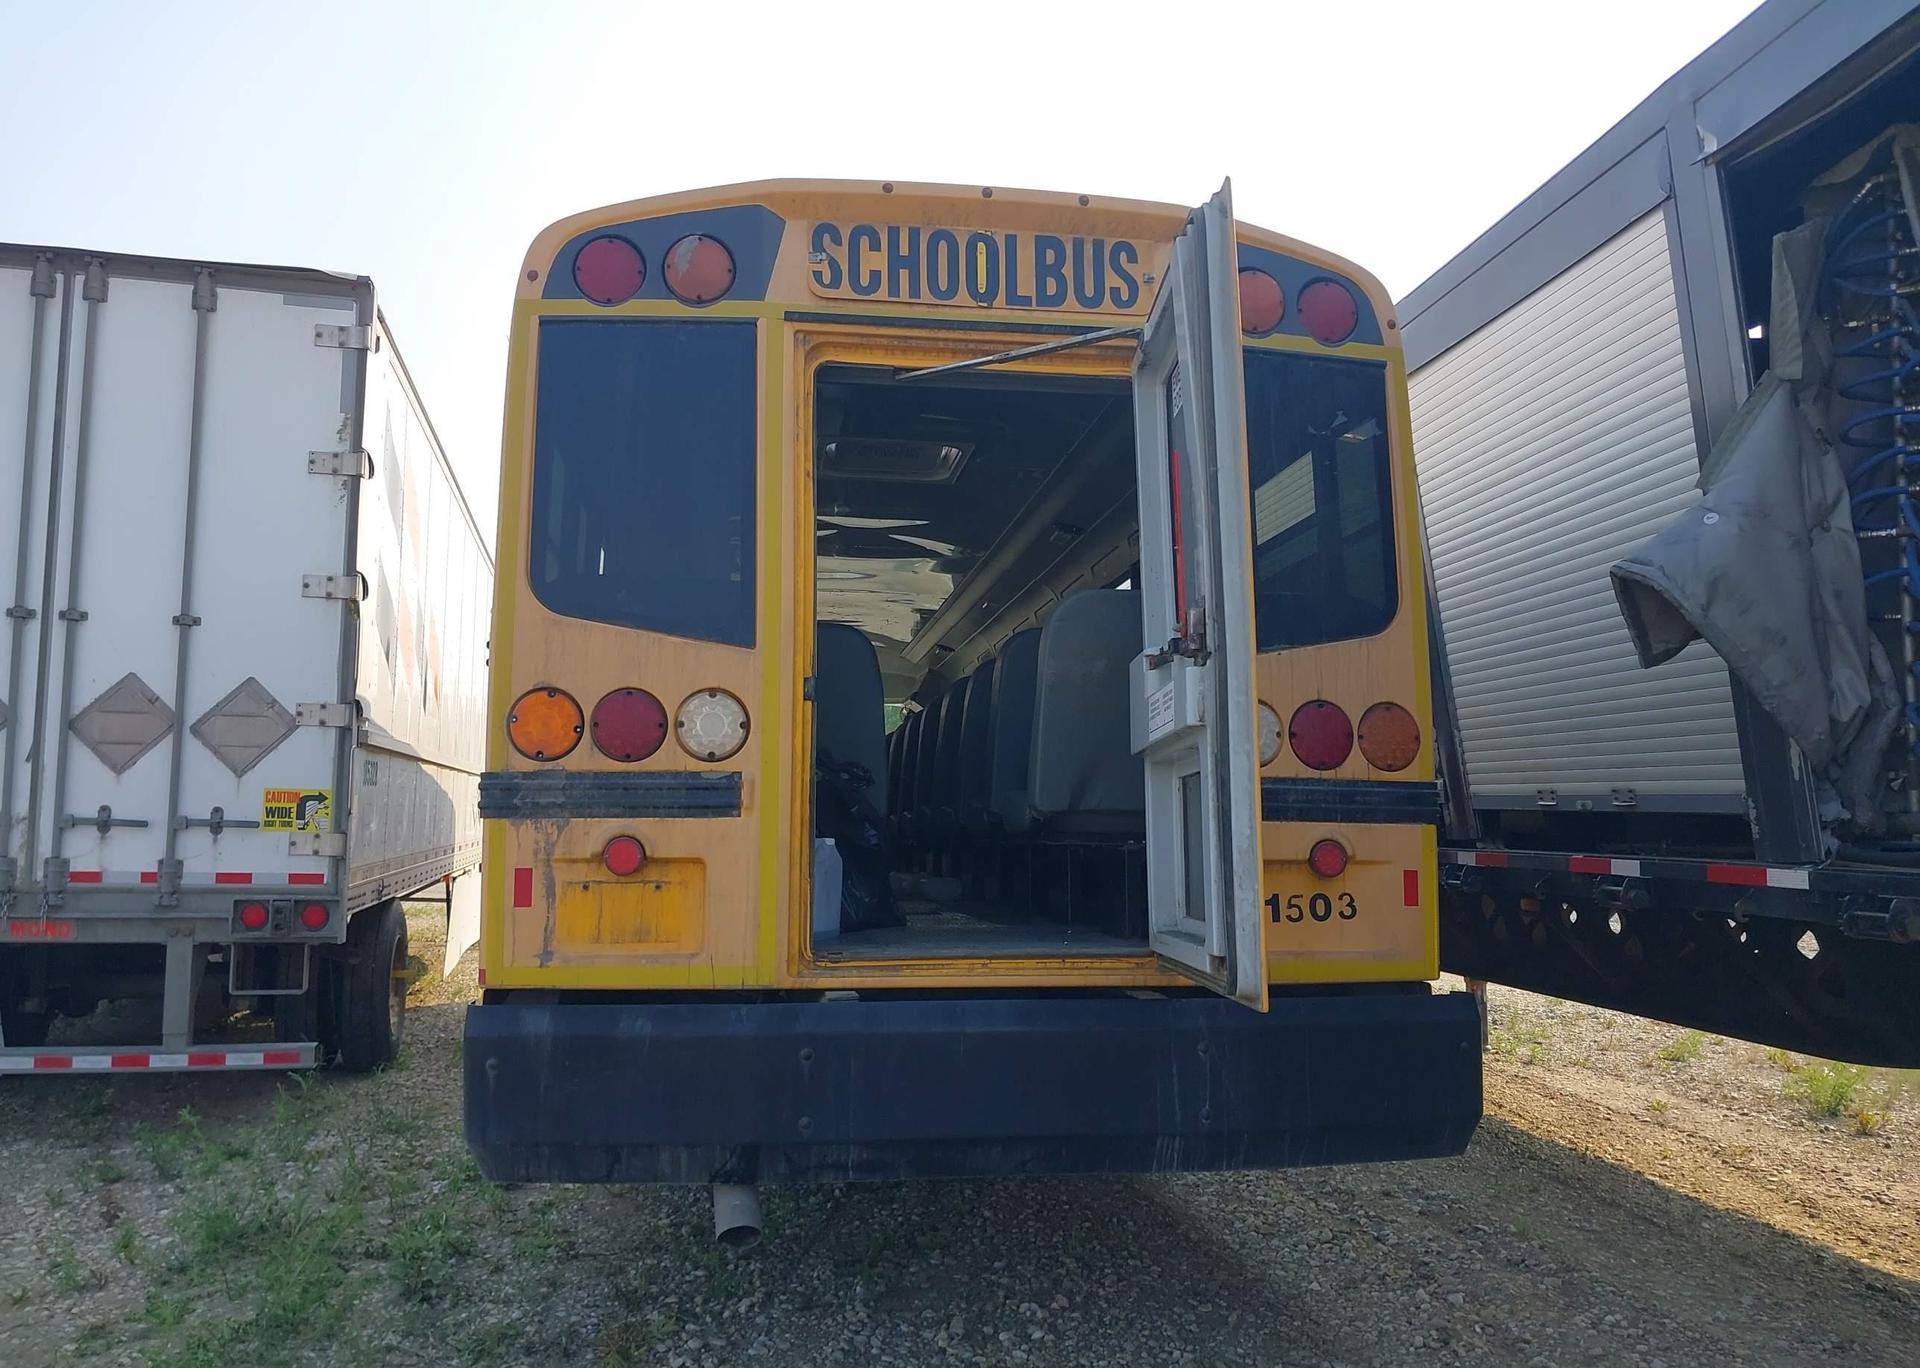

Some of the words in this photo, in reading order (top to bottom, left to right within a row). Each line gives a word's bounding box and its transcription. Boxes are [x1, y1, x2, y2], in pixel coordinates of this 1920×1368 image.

[265, 790, 302, 804] CAUTION
[265, 806, 294, 819] WIDE
[1264, 892, 1358, 923] 1503
